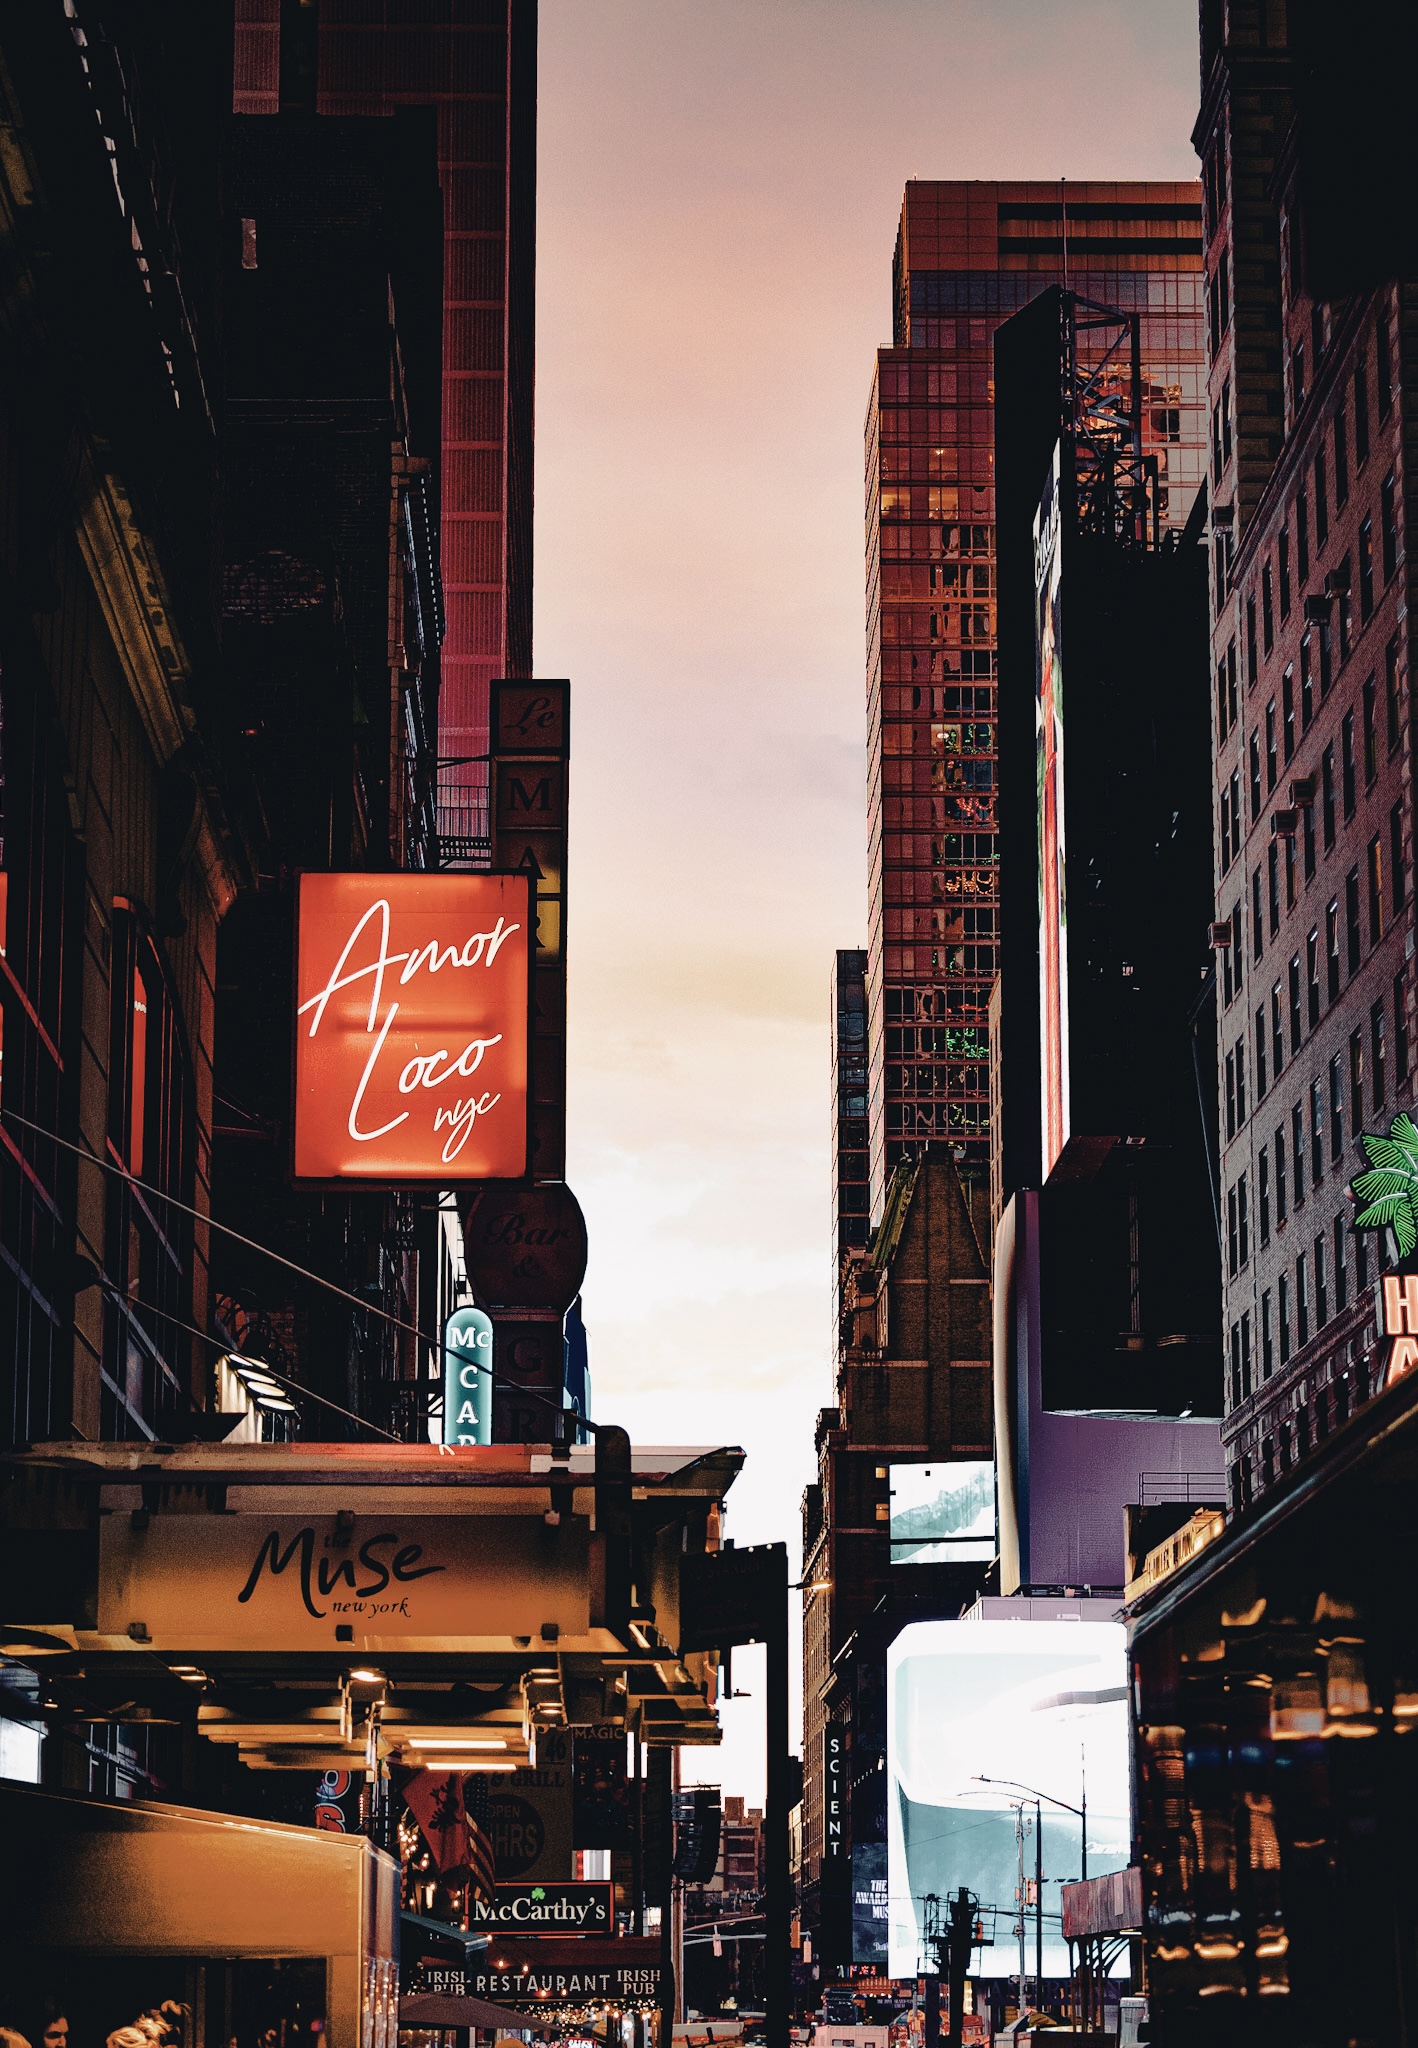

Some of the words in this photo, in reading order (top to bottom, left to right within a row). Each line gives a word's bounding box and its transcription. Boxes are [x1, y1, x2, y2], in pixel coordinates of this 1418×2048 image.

[503, 696, 559, 736] Le
[297, 898, 521, 1038] Amor
[347, 1001, 503, 1142] Loco
[431, 1090, 502, 1163] nyc
[485, 1213, 574, 1247] Bar
[332, 1601, 368, 1613] new
[367, 1597, 412, 1619] york
[574, 1727, 625, 1740] MAGIC
[510, 1770, 566, 1788] GRILL
[473, 1896, 606, 1925] McCarthy's
[476, 1974, 611, 1993] RESTAURANT
[616, 1969, 661, 1983] IRISH
[622, 1982, 656, 1995] PUB
